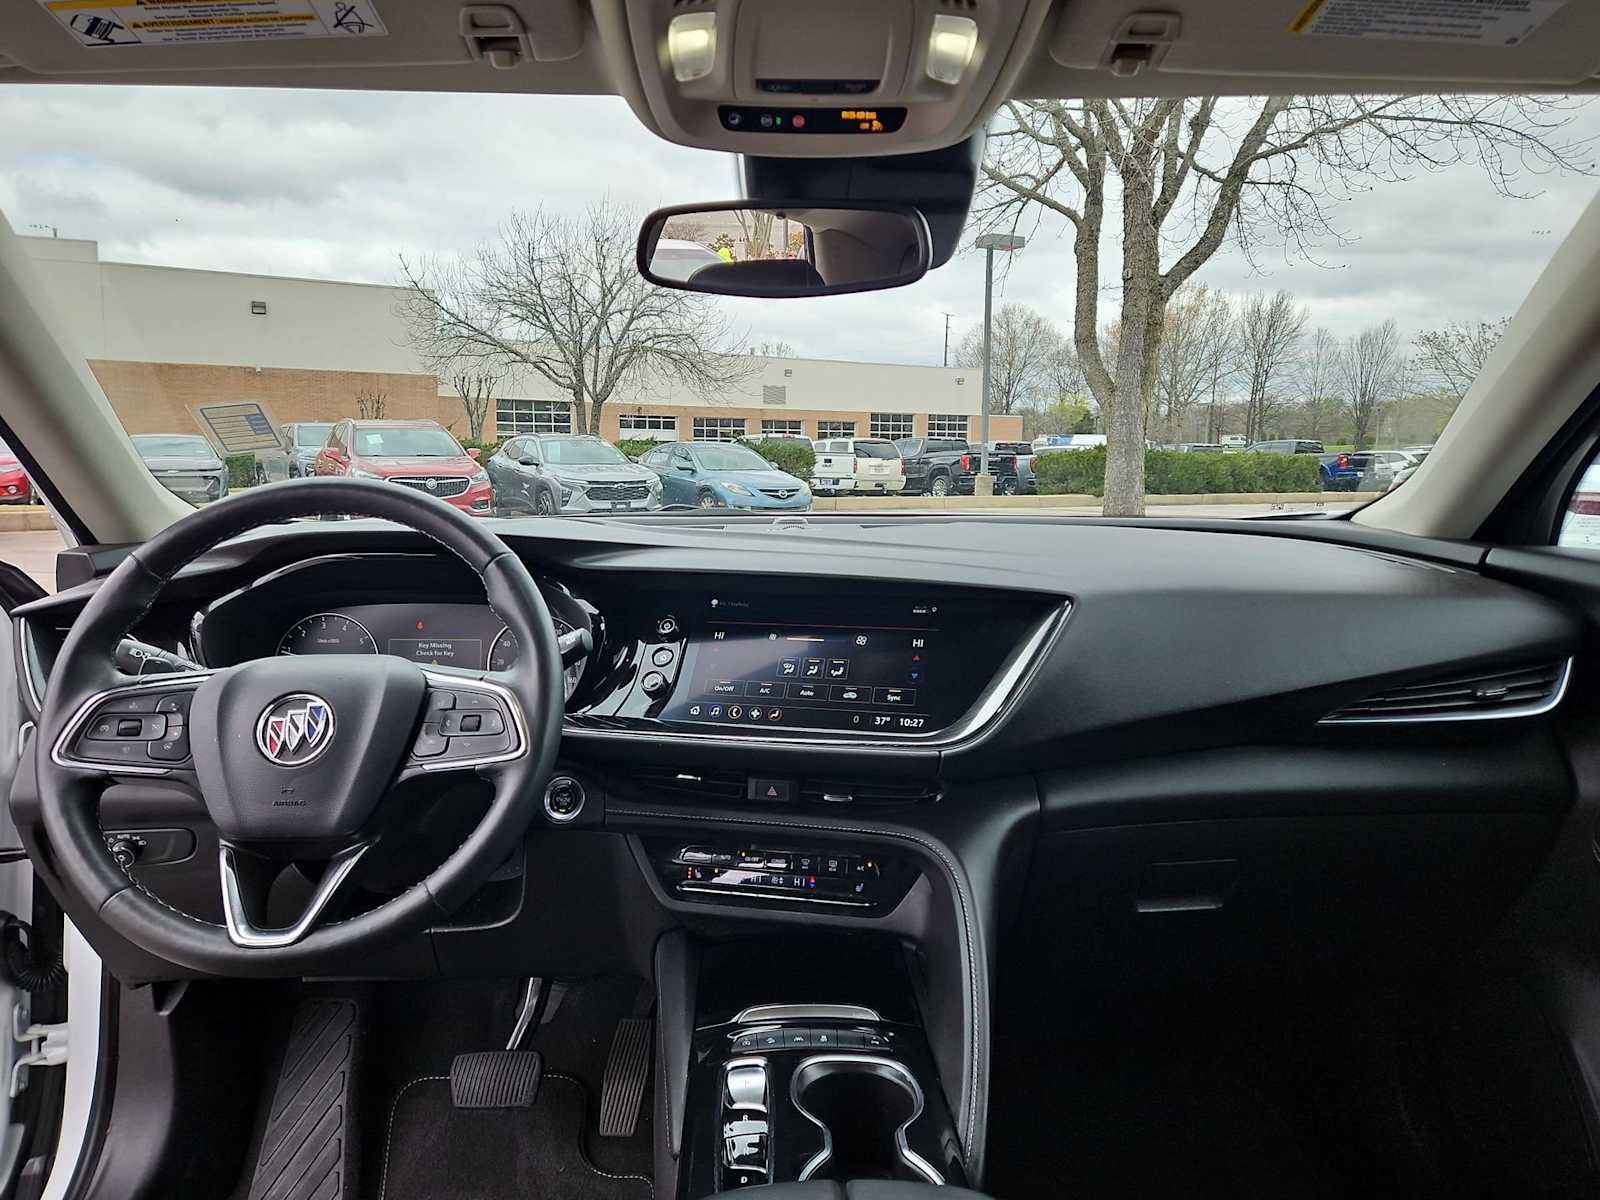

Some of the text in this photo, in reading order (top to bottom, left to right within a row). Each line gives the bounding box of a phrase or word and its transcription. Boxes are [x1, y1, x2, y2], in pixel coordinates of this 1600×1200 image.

[912, 639, 924, 647] HI
[900, 718, 925, 727] 10:27
[740, 1176, 748, 1184] D
